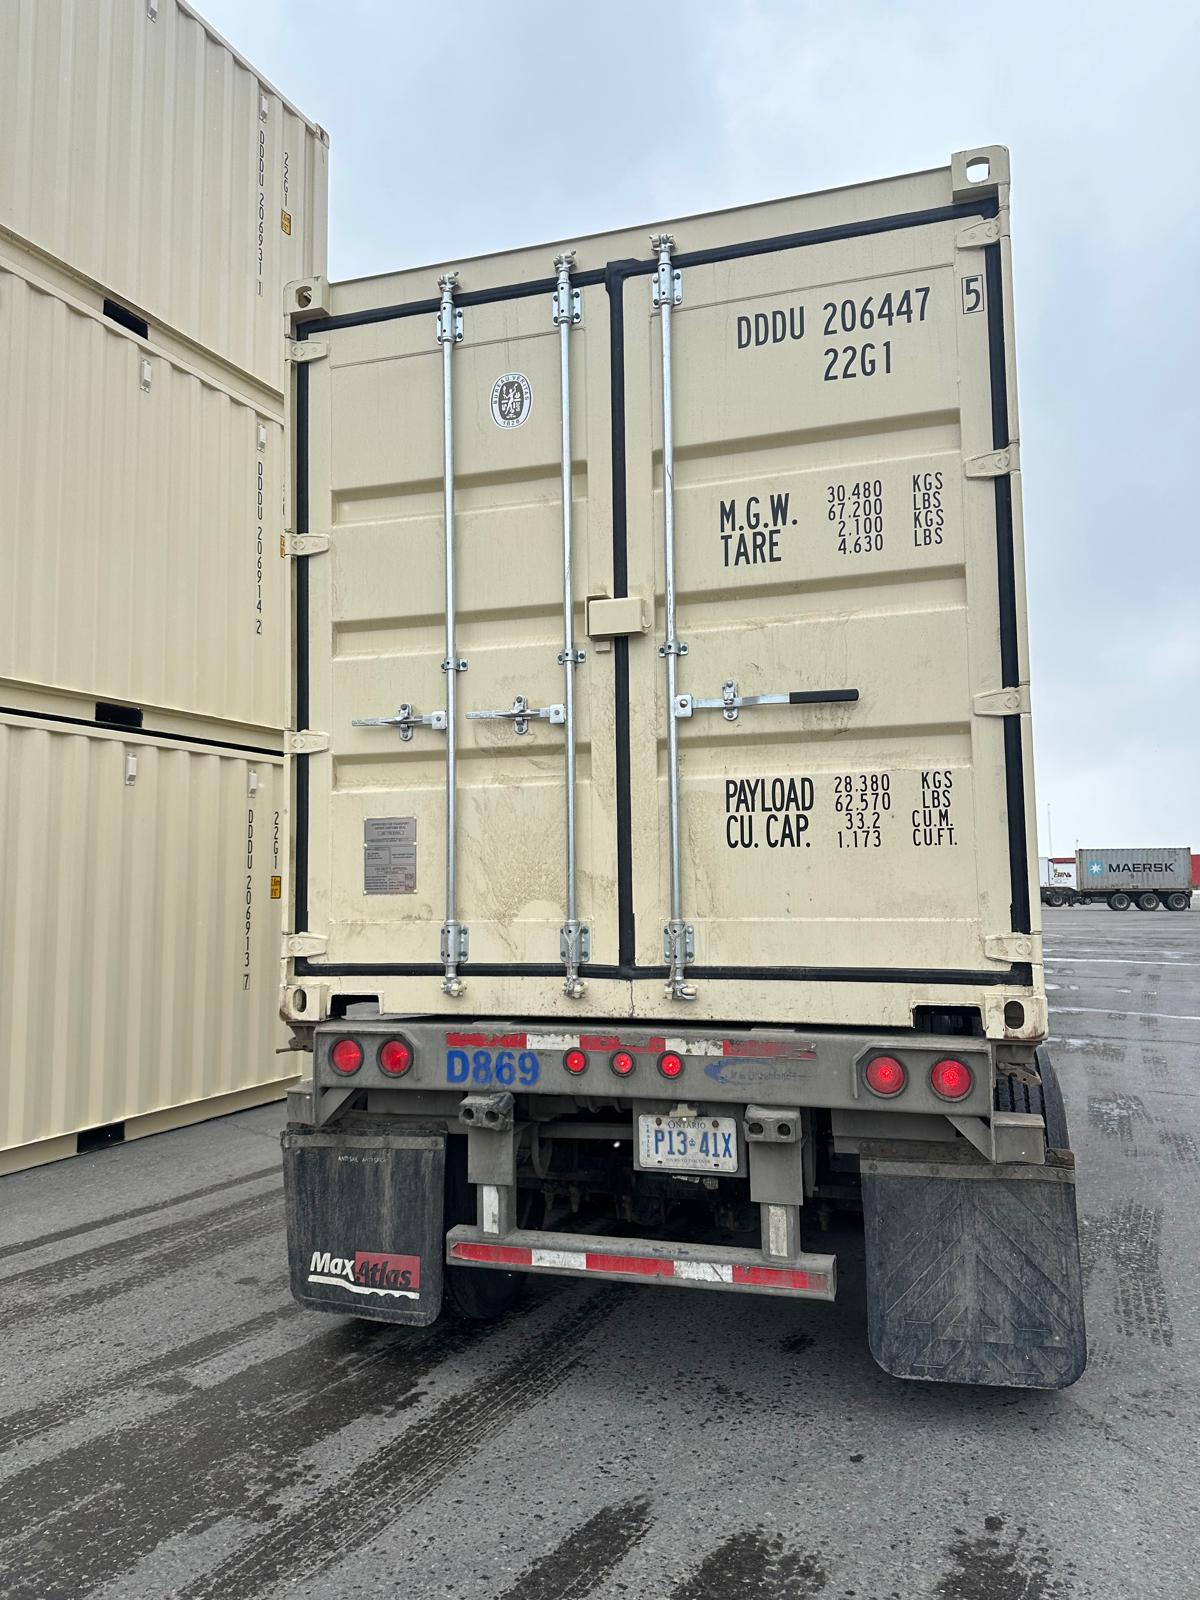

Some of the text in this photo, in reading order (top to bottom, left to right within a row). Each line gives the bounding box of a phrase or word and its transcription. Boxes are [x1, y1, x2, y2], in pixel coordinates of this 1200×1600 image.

[737, 277, 981, 349] DDDU 206447 5
[823, 341, 892, 381] 22G1
[719, 472, 943, 533] M.G.W. 30.480 KGS
[828, 491, 942, 521] 67.200 LBS
[720, 508, 944, 567] TARE 2.100 KGS
[838, 527, 943, 555] 4.630 LBS
[725, 771, 953, 813] PAYLOAD 28.380 KGS
[835, 790, 951, 812] 62.570 LBS
[726, 810, 954, 849] CU. CAP. 33.2 CU.M.
[837, 828, 958, 849] 1.173 CU.FT.
[1108, 863, 1175, 873] MAERSK
[244, 875, 252, 968] 206913
[446, 1051, 539, 1086] D869
[667, 1120, 706, 1129] ONTARIO
[310, 1252, 412, 1288] Max Atlas
